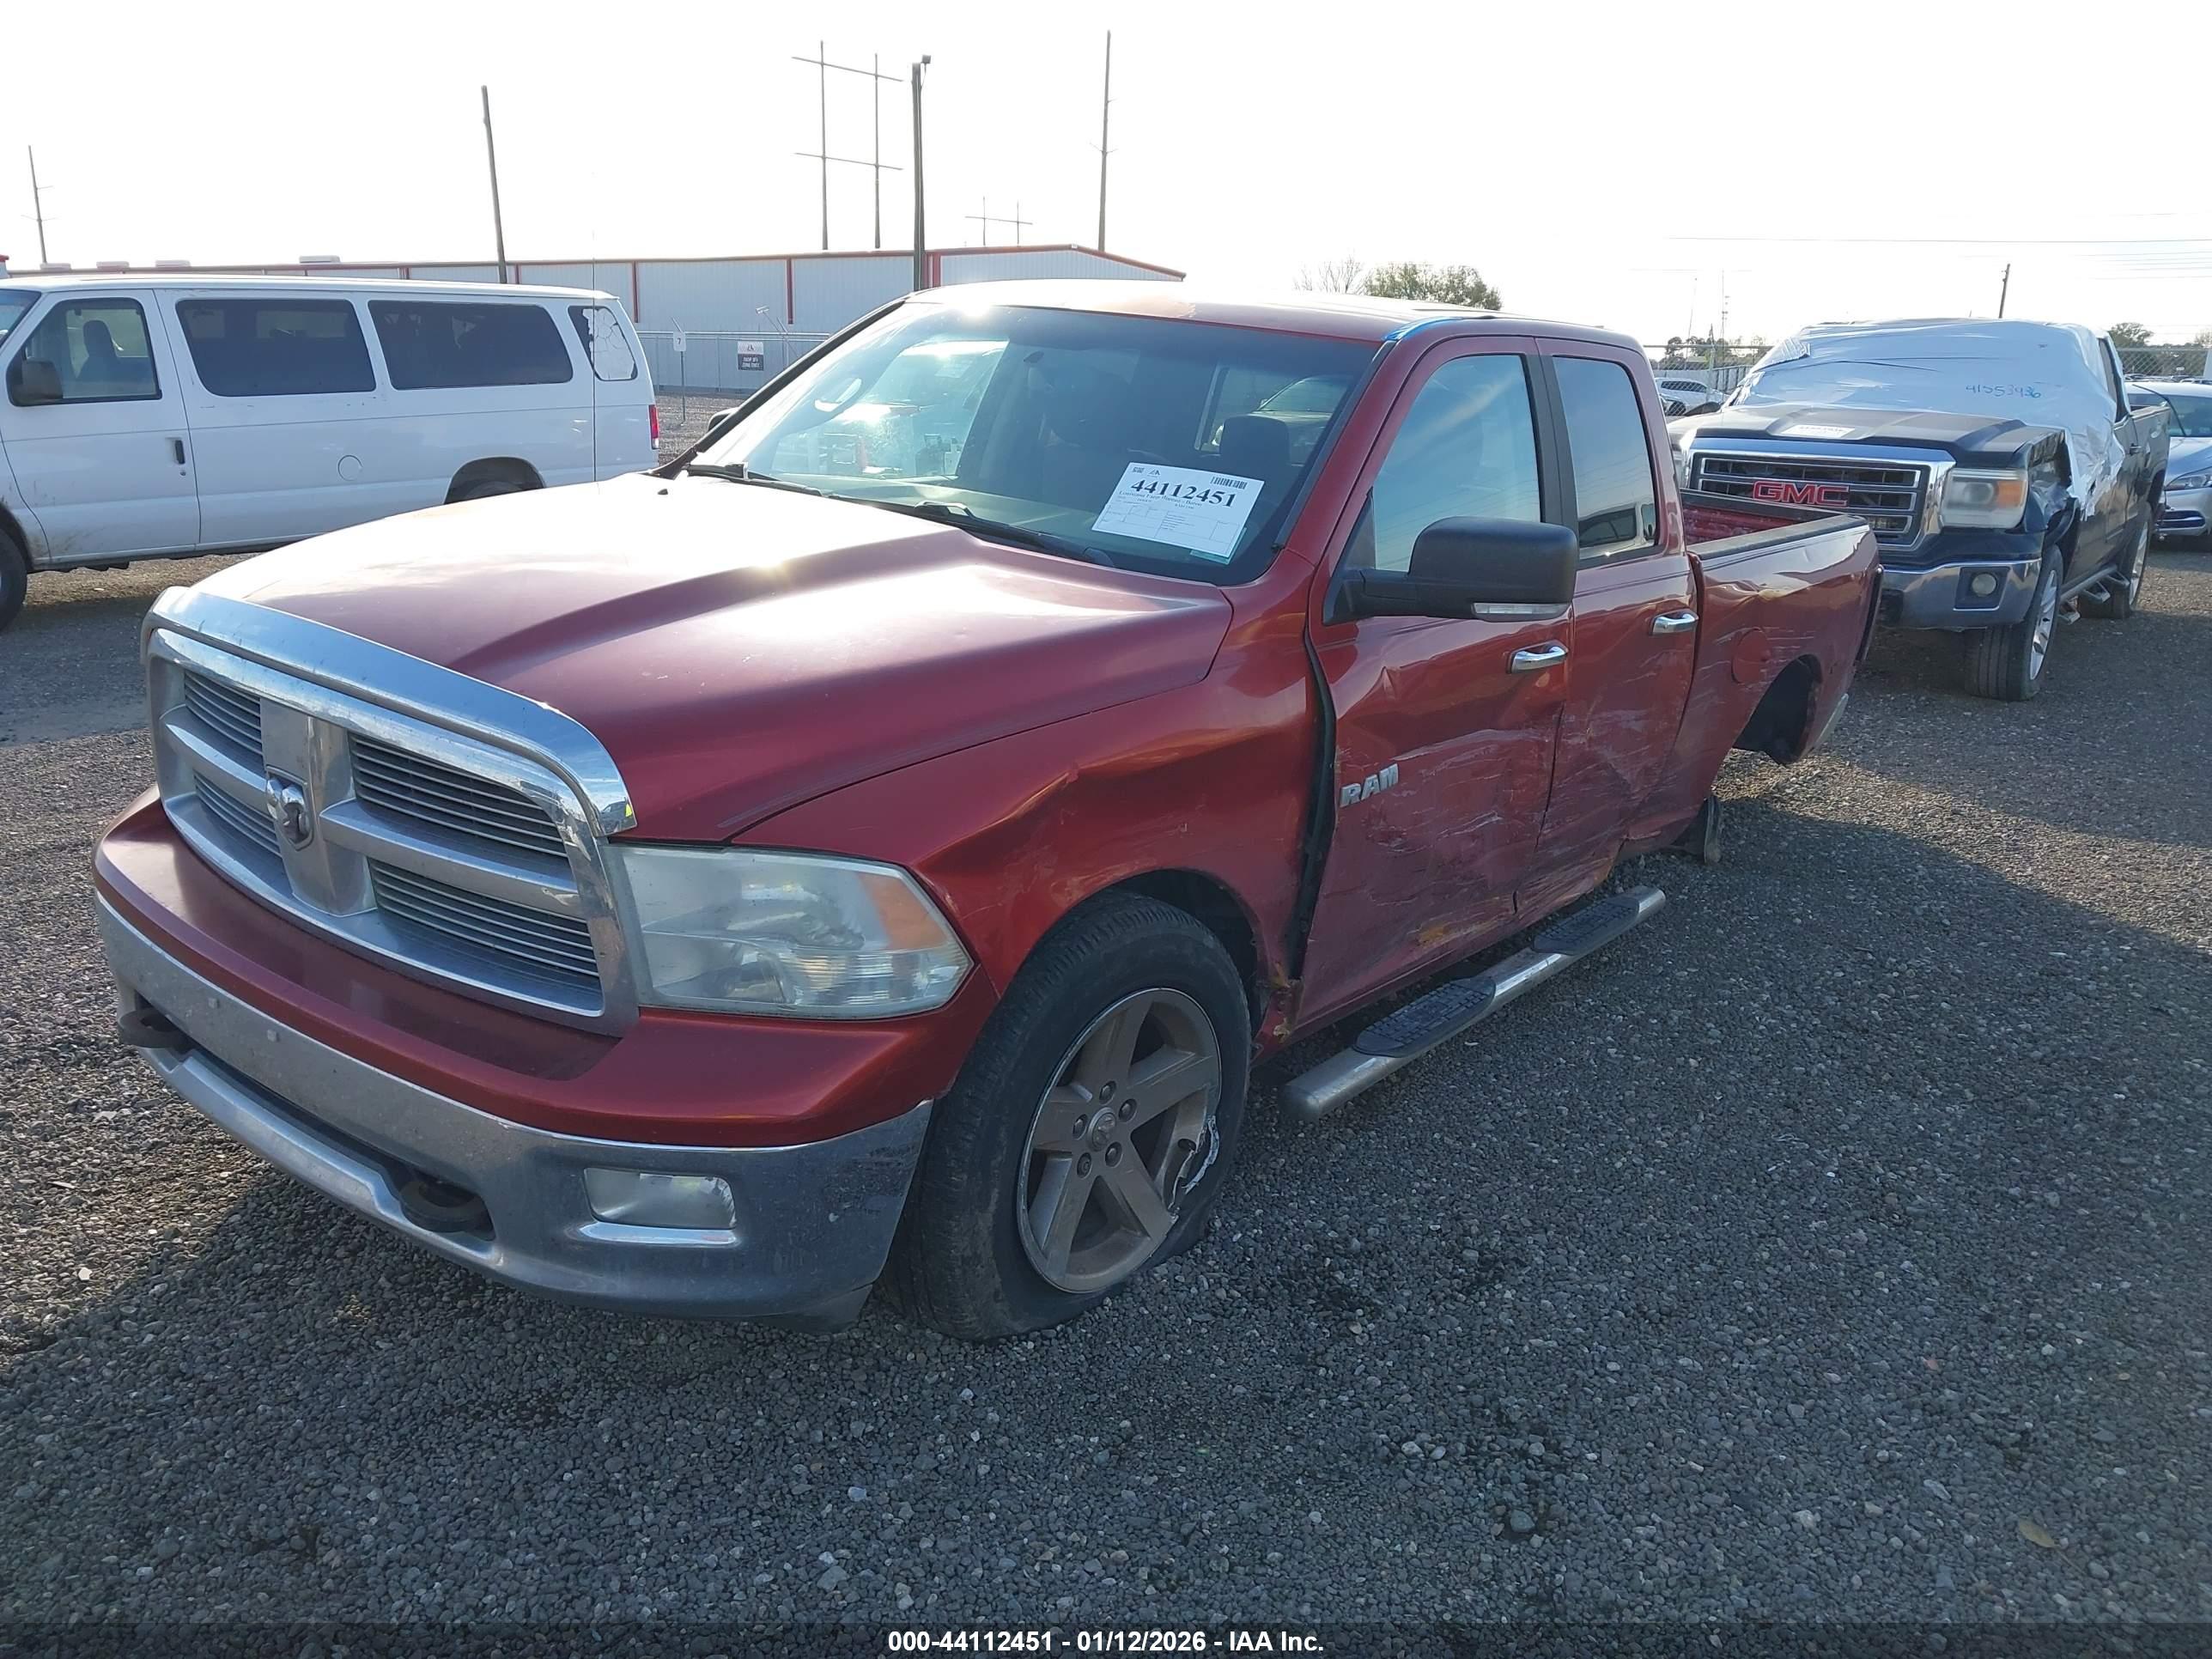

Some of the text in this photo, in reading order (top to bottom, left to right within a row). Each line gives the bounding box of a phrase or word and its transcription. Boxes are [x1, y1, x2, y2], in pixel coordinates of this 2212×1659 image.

[1131, 479, 1236, 507] 44112451
[1753, 480, 1849, 507] GMC
[1340, 763, 1399, 808] RAM
